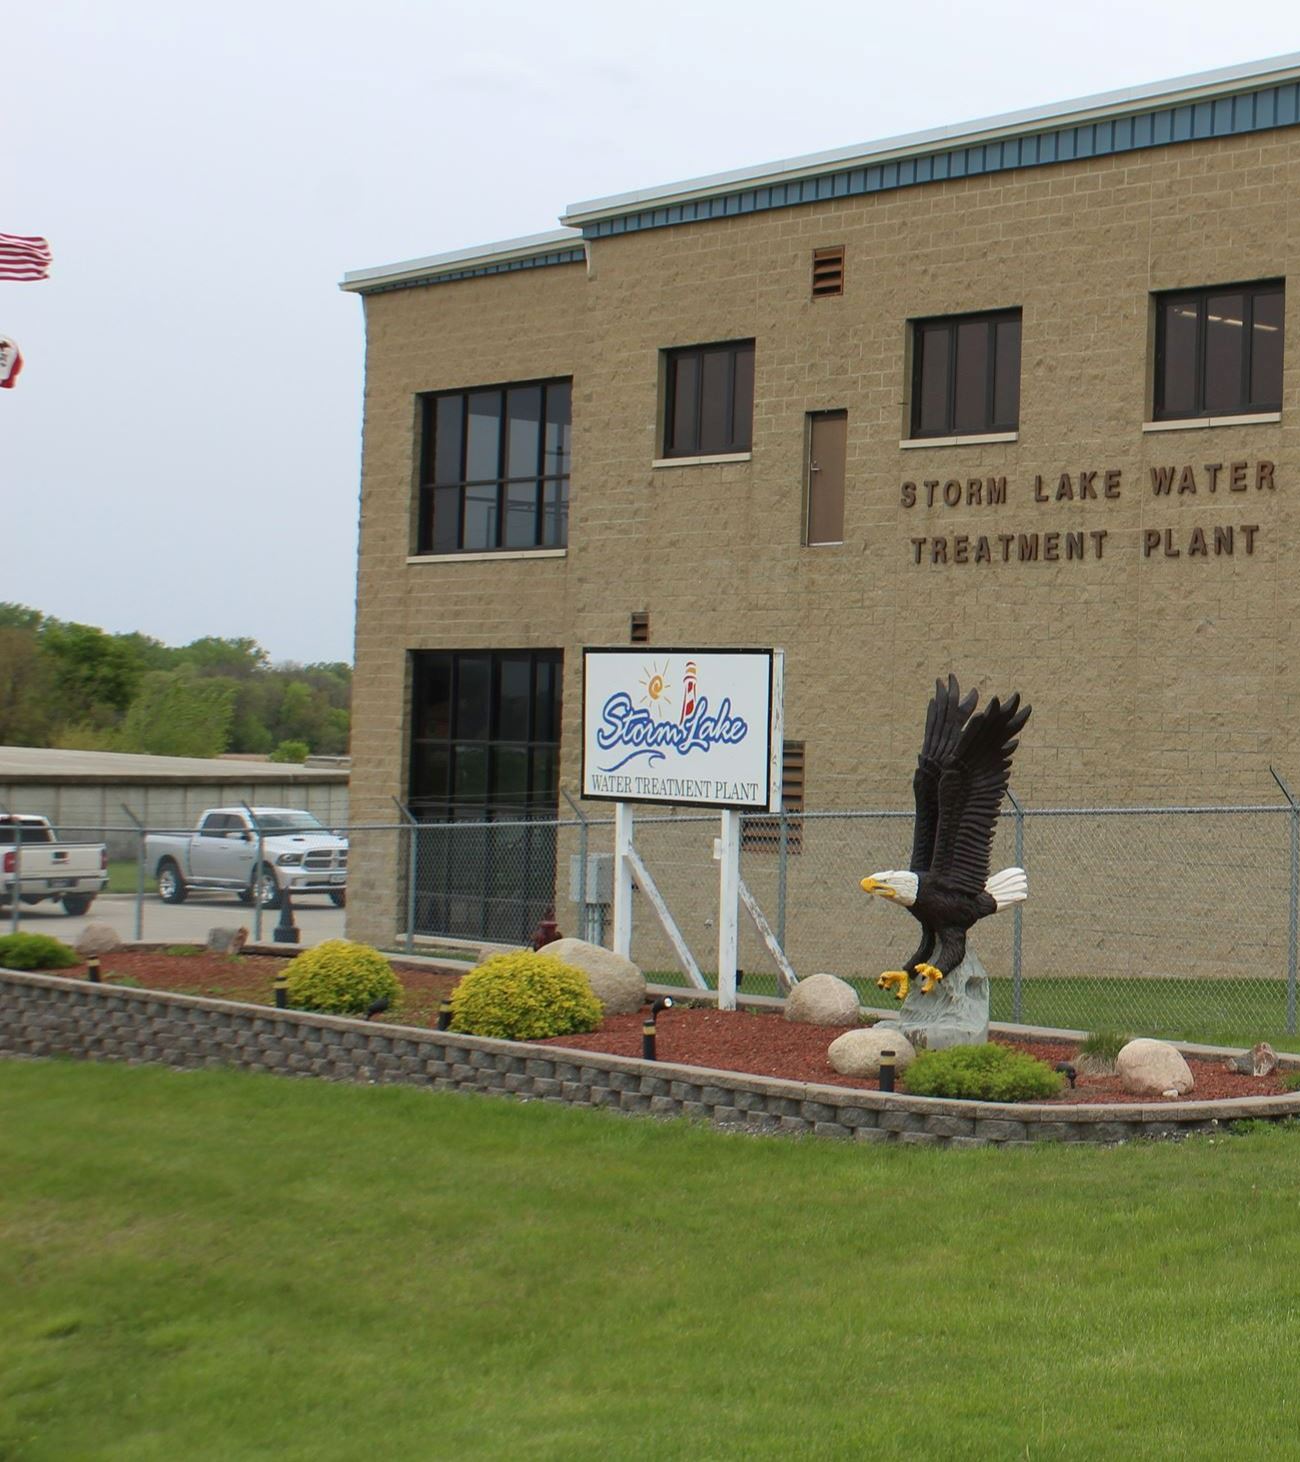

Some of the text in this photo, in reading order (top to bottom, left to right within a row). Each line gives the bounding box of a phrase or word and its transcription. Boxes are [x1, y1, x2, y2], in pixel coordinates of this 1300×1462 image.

[900, 460, 1276, 508] STORM LAKE WATER
[911, 525, 1260, 564] TREATMENT PLANT
[597, 692, 748, 755] Storm Lake
[592, 774, 759, 801] WATER TREATMENT PLANT
